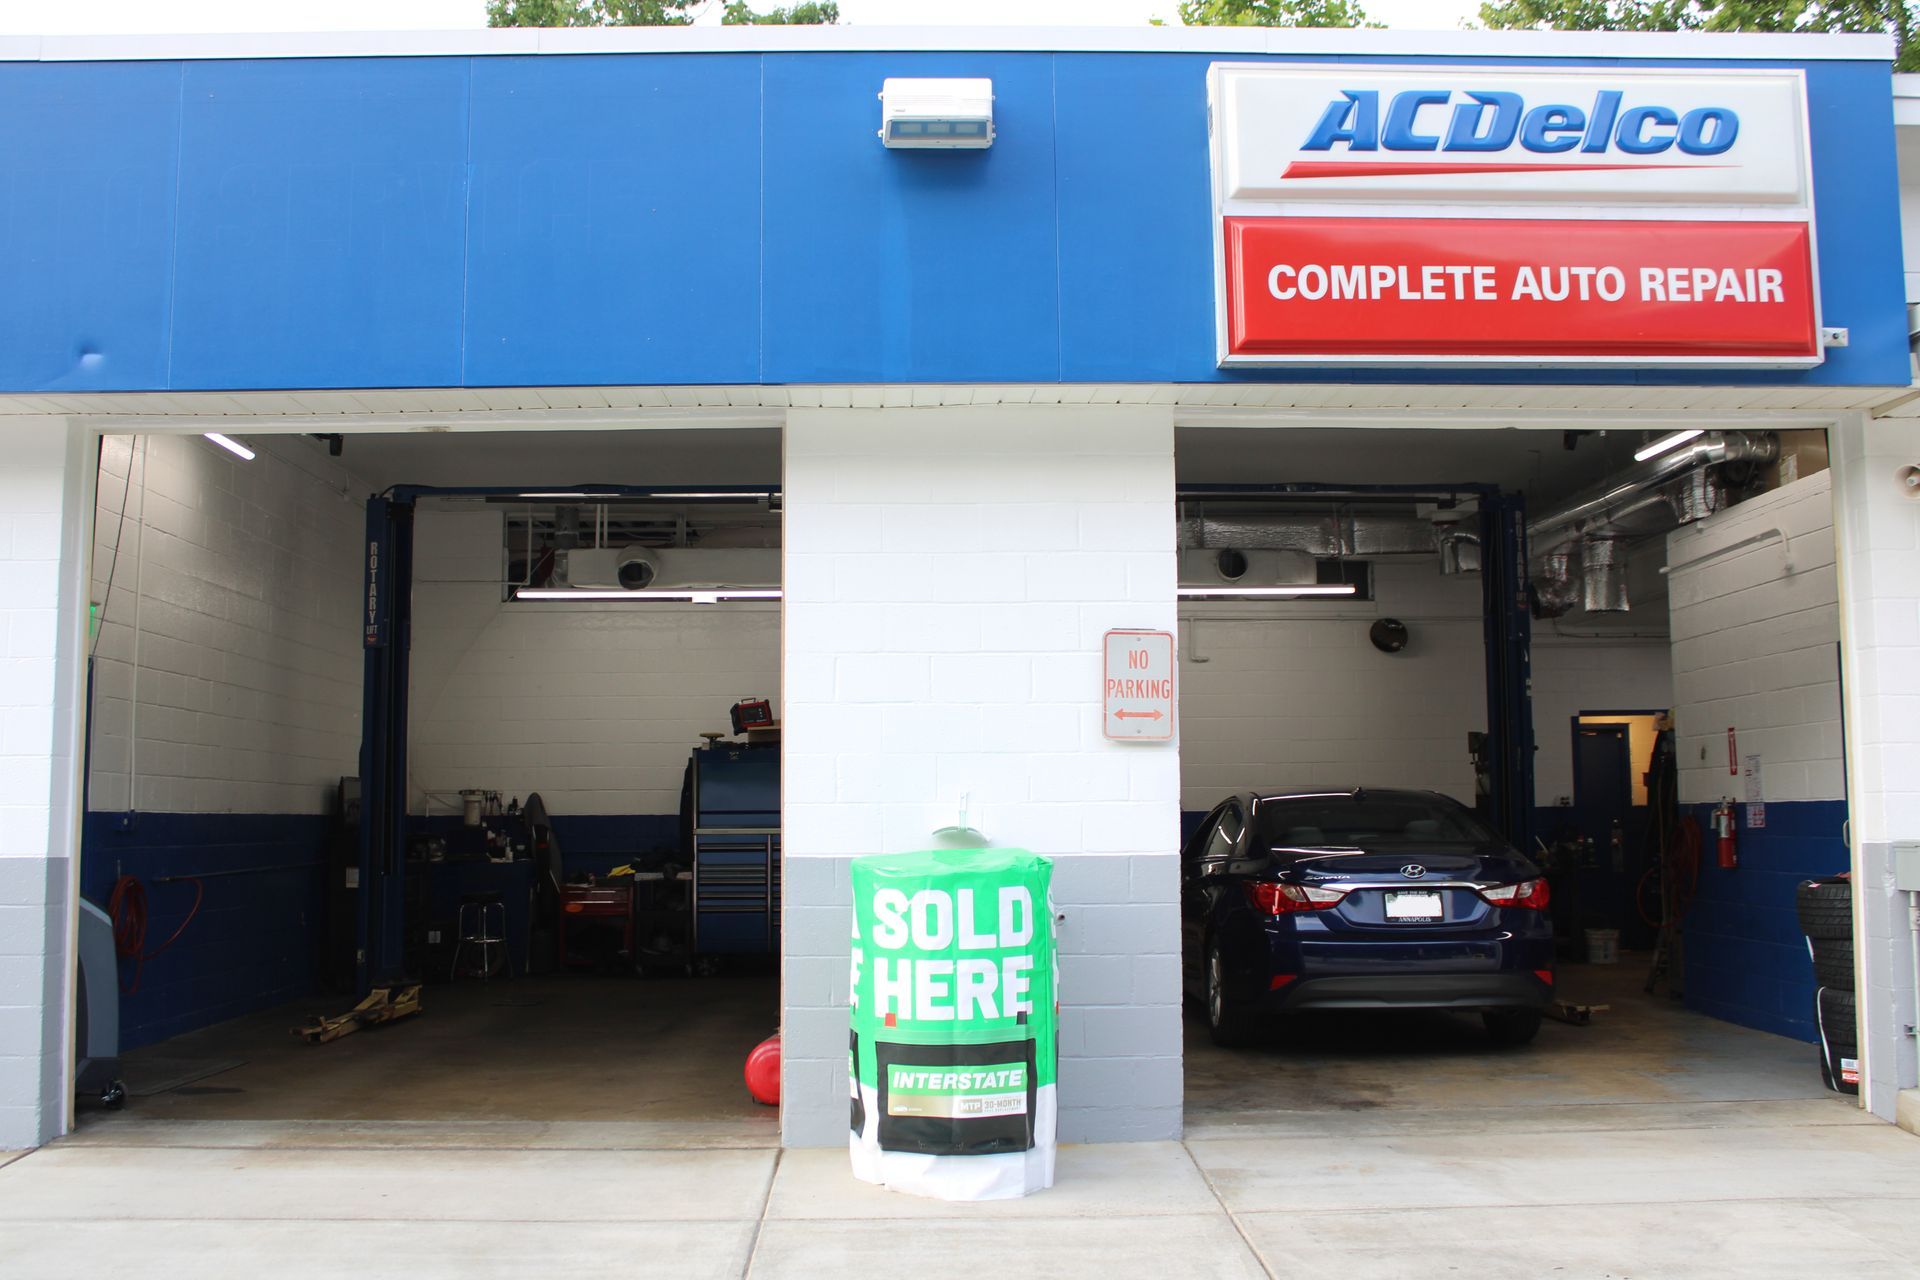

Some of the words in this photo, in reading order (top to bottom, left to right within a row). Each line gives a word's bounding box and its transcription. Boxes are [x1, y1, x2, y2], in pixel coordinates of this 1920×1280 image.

[1299, 89, 1740, 156] ACDelco
[1267, 264, 1498, 301] COMPLETE
[1511, 266, 1626, 303] AUTO
[1639, 267, 1785, 304] REPAIR
[369, 541, 378, 624] ROTARY
[366, 625, 378, 634] LIFT
[1128, 650, 1149, 670] NO
[1107, 678, 1170, 699] PARKING
[873, 887, 1033, 949] SOLD
[873, 956, 1034, 1020] HERE
[893, 1070, 1023, 1090] INTERSTATE
[961, 1101, 982, 1112] MTP
[984, 1099, 1022, 1109] 30-MONTH
